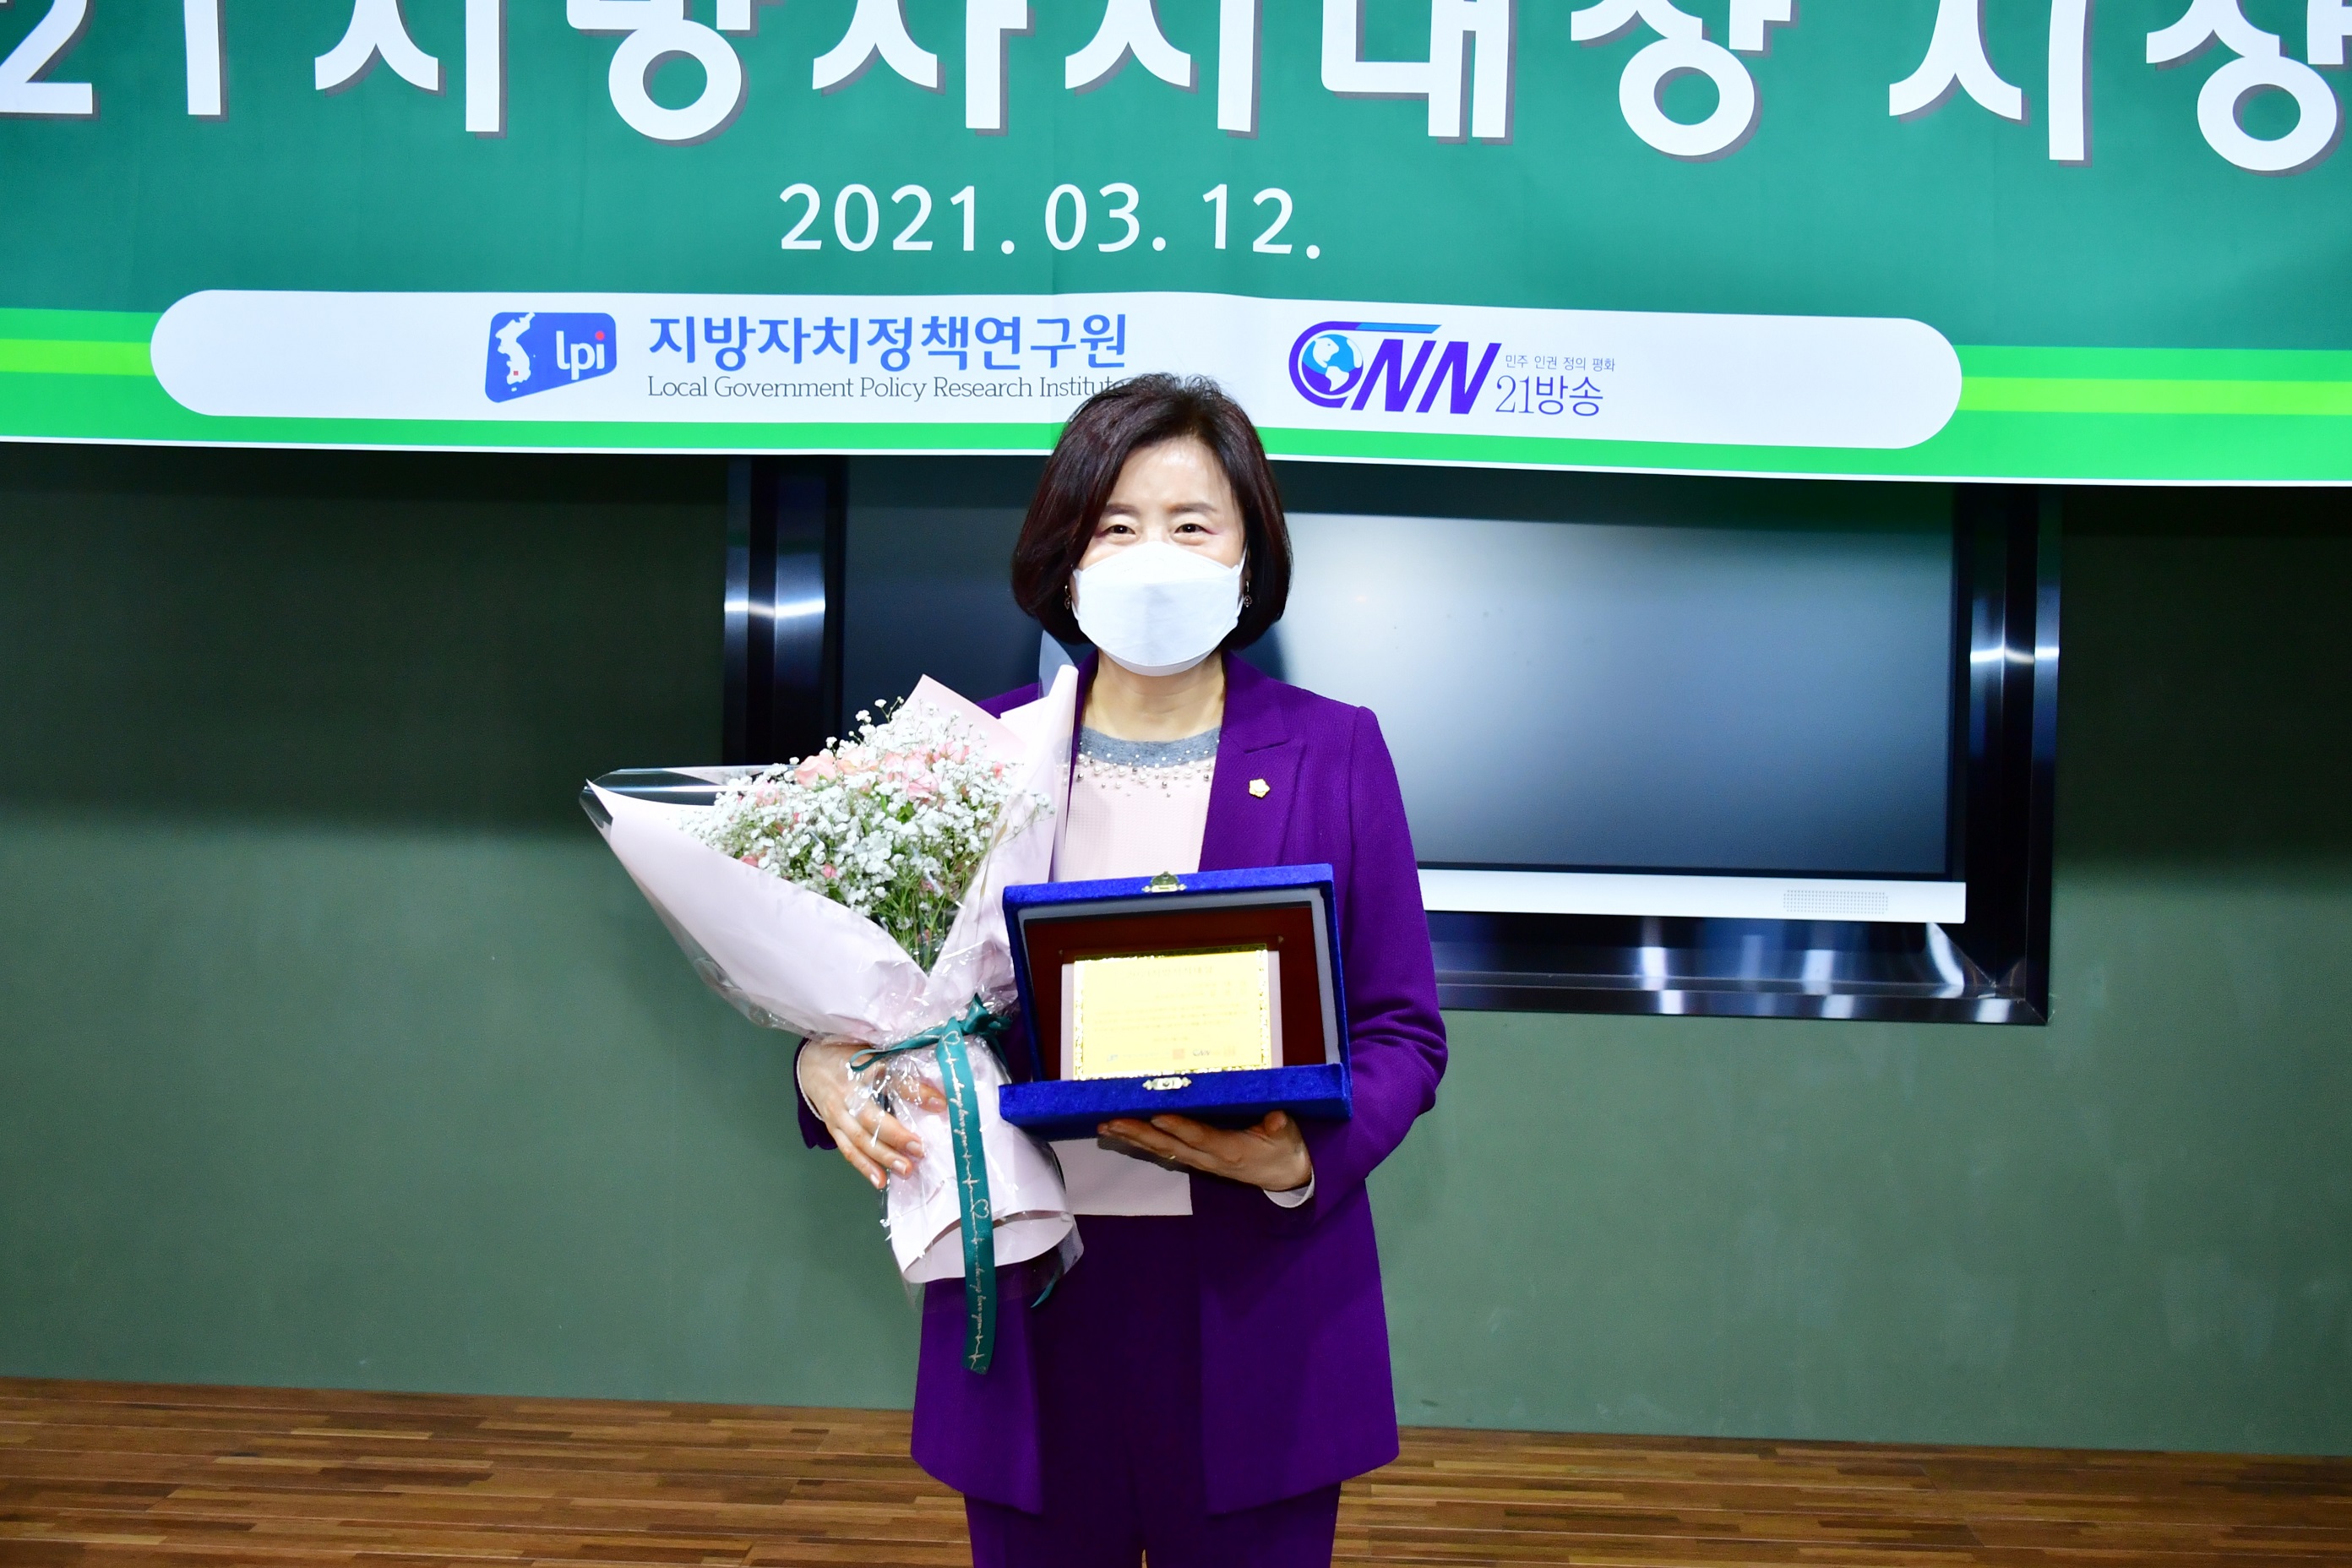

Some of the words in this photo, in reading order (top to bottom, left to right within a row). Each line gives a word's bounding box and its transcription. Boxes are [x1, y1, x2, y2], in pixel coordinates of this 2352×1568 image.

[780, 183, 1015, 254] 2021.
[1045, 182, 1167, 253] 03.
[1202, 183, 1321, 259] 12.
[649, 313, 1126, 373] 지방자치정책연구원
[1505, 354, 1528, 368] 민주
[1533, 355, 1558, 370] 인권
[1563, 357, 1587, 371] 정의
[1592, 357, 1616, 372] 평화
[647, 375, 708, 397] Local
[714, 375, 854, 398] Government
[859, 376, 928, 403] Policy
[933, 376, 1033, 398] Research
[1039, 375, 1113, 398] Institut
[1494, 374, 1604, 416] 21방송
